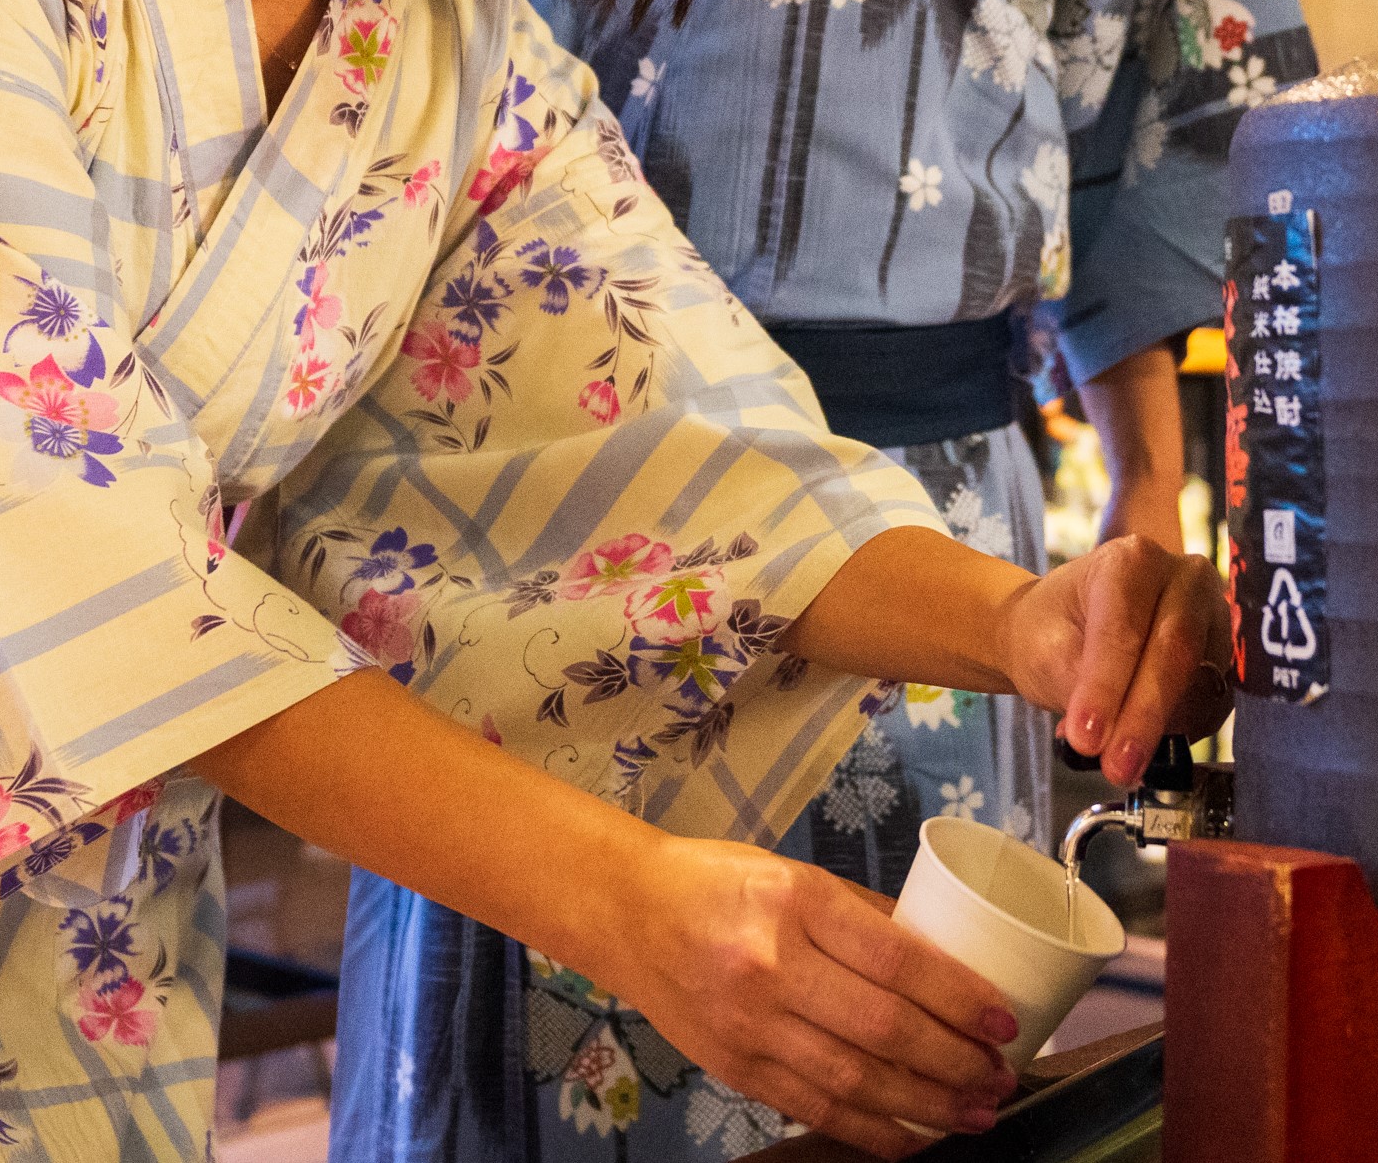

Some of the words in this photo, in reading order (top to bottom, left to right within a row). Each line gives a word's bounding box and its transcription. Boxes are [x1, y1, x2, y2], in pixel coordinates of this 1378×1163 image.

[1250, 273, 1274, 415] 純米仕込
[1271, 259, 1303, 427] 本格焼酎
[1272, 666, 1301, 690] PET
